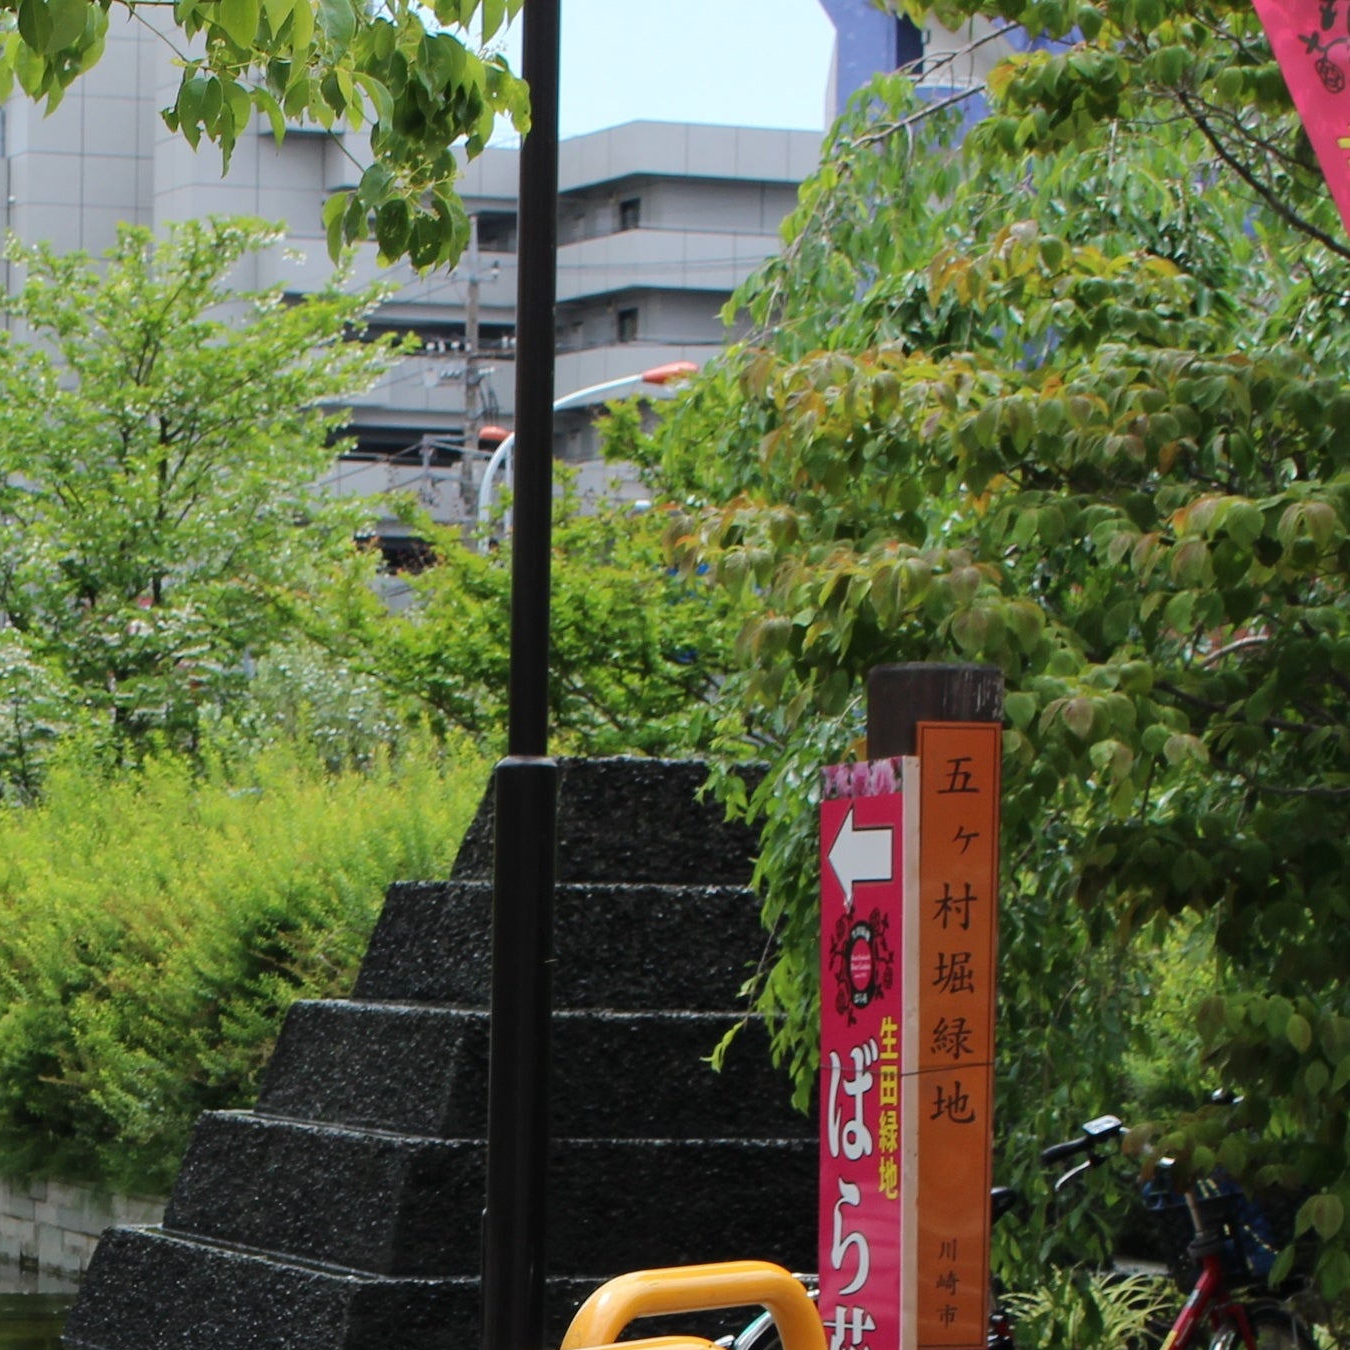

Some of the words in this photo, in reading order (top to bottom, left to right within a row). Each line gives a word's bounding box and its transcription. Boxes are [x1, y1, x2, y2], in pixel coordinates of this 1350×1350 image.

[877, 1015, 900, 1200] 生田緑地
[935, 1238, 961, 1330] 川崎市
